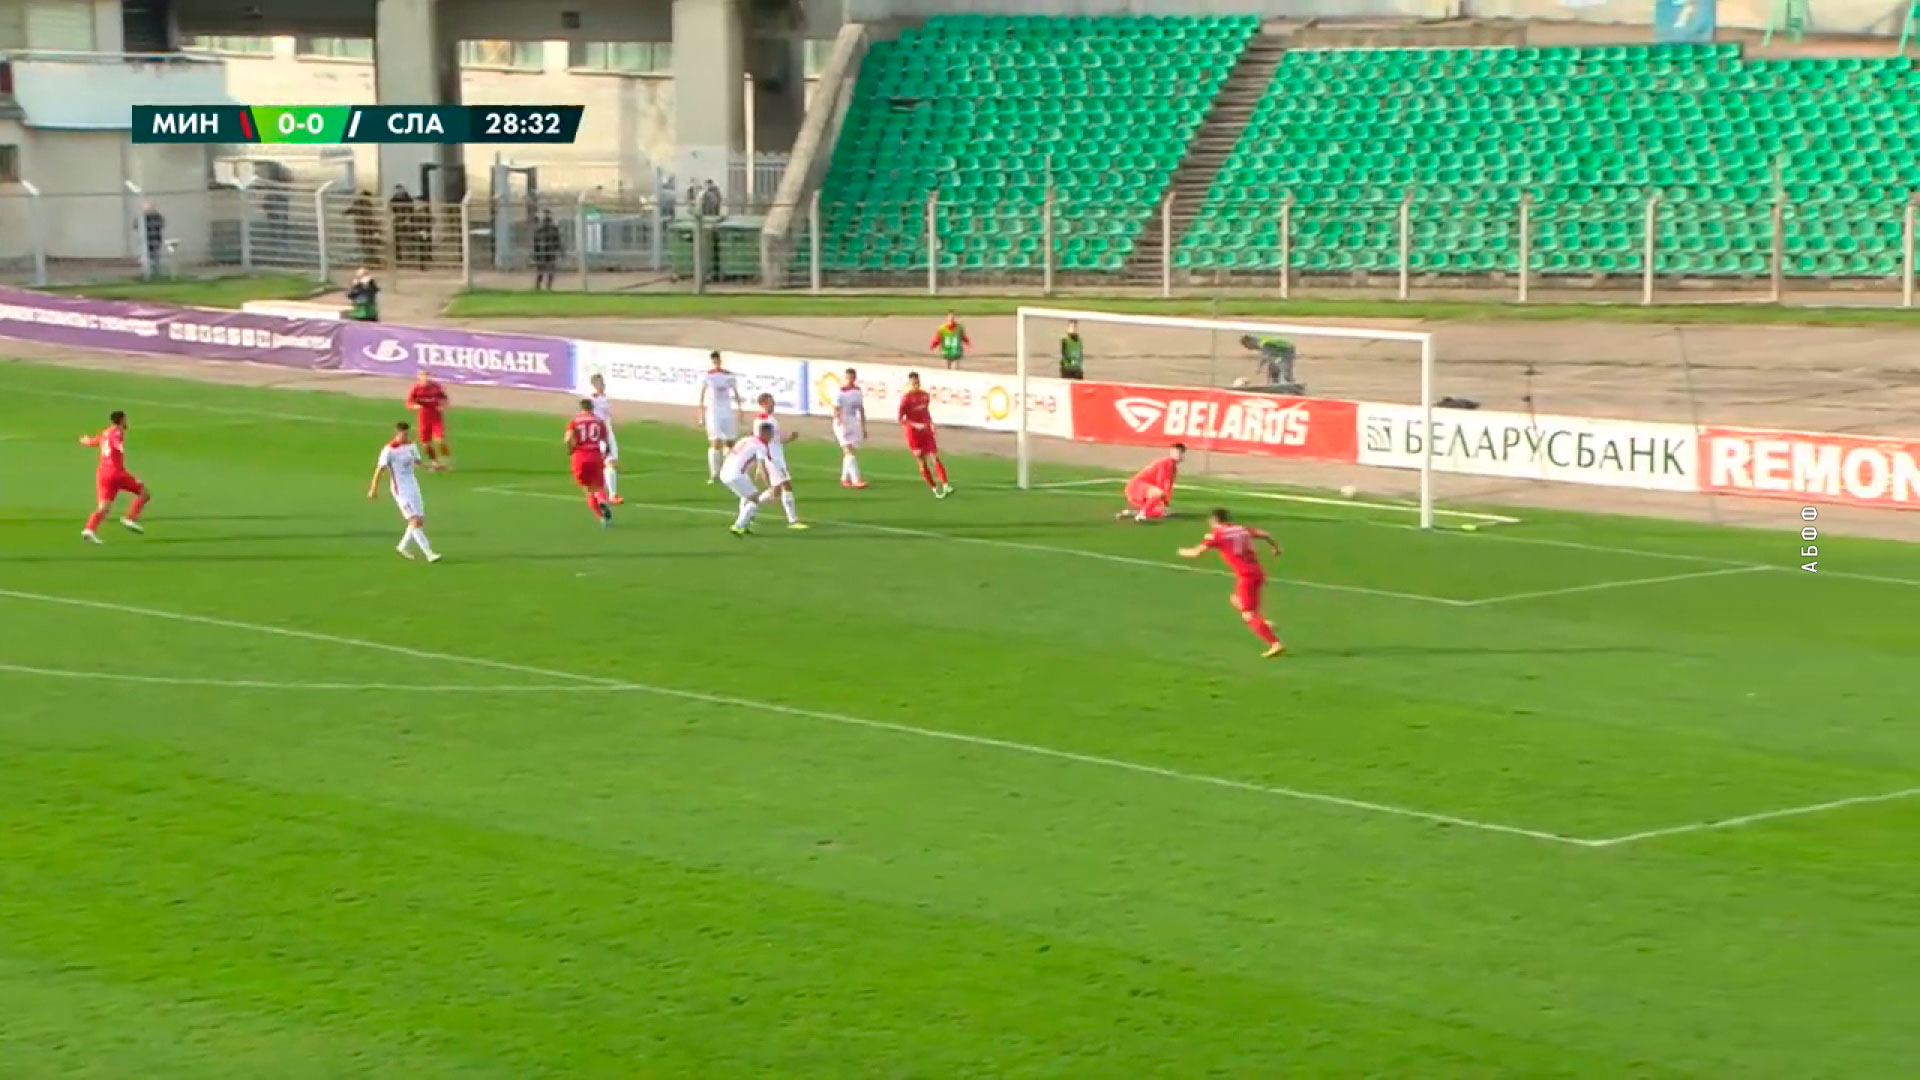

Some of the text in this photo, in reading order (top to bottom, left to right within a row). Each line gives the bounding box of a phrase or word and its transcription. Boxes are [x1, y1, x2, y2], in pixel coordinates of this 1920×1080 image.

[413, 342, 552, 376] ТЕХНОБАНК
[577, 422, 601, 442] 10
[1163, 399, 1310, 446] BELARUS
[1405, 424, 1686, 476] БЕЛАРУСБАНК
